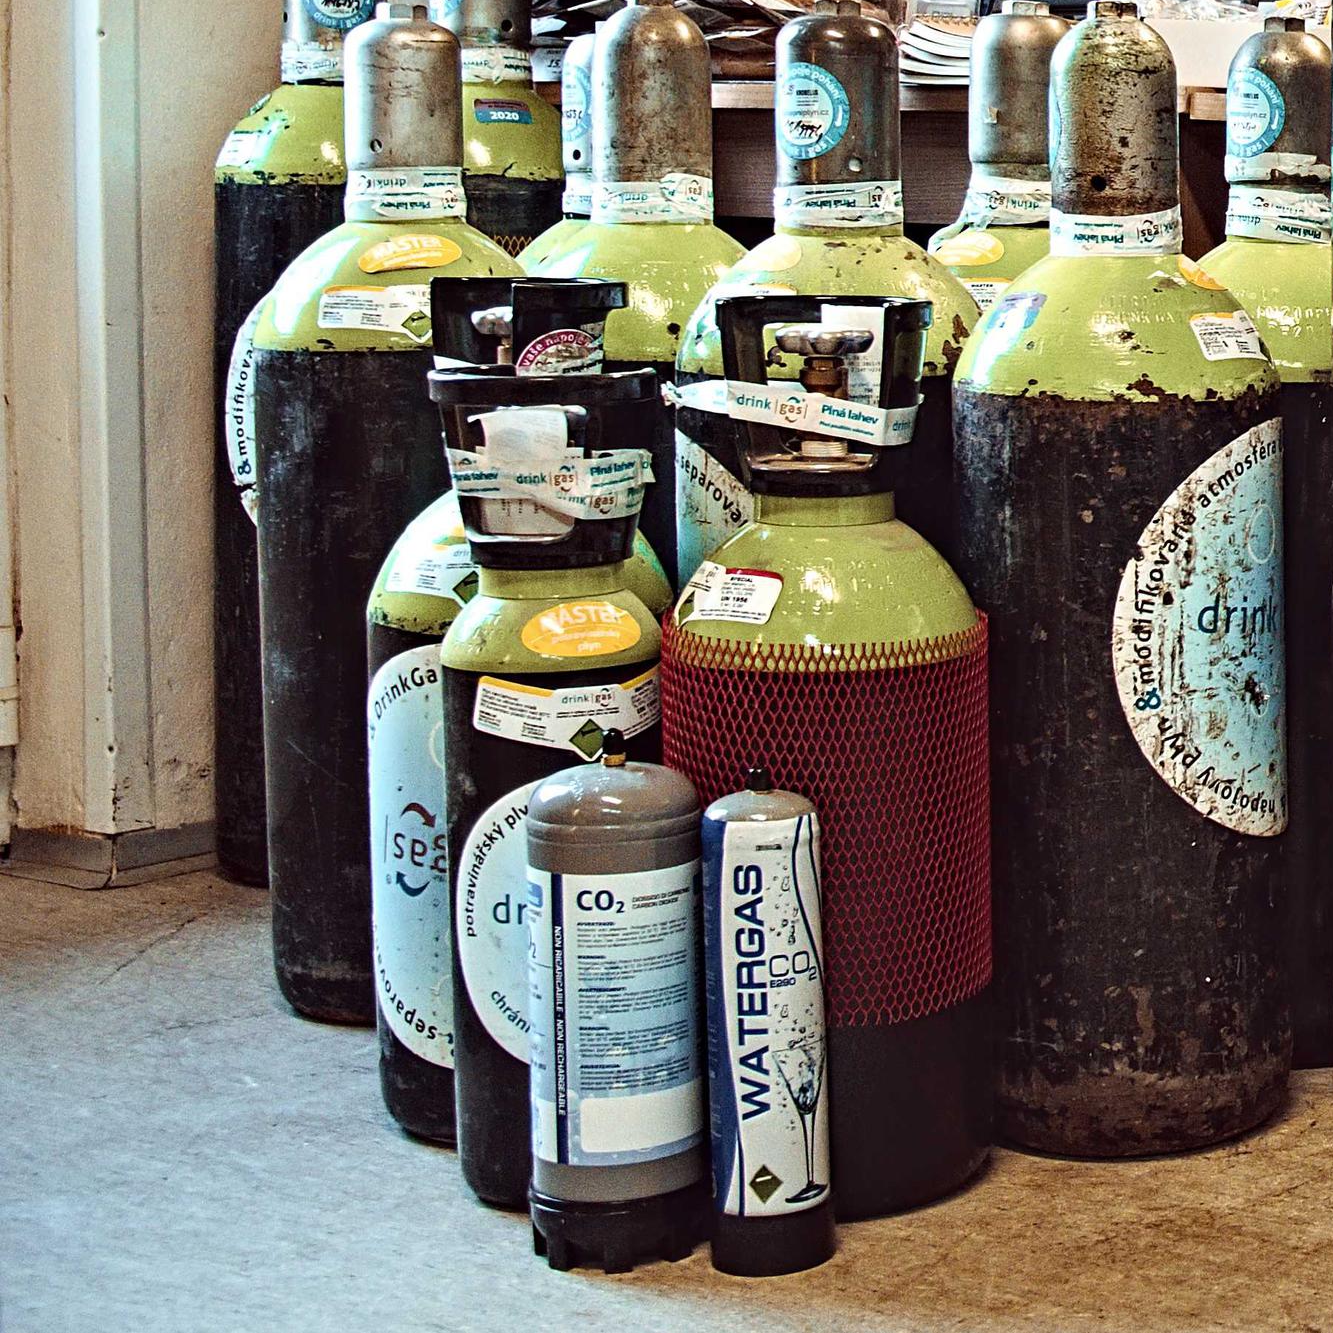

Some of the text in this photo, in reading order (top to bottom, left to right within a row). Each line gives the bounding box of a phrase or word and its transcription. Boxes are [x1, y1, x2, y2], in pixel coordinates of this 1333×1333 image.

[489, 110, 520, 121] 2020
[372, 232, 442, 262] MASTER
[521, 341, 545, 367] vaše
[735, 392, 772, 411] drink
[778, 399, 804, 417] gas
[820, 403, 848, 422] Plná
[849, 408, 880, 426] lahev
[237, 455, 253, 475] &
[515, 471, 546, 487] drink
[554, 472, 575, 488] gas
[589, 462, 610, 477] Plná
[612, 459, 636, 474] lahev
[1197, 594, 1278, 634] drink
[560, 691, 615, 706] drink gas
[465, 823, 505, 938] potravinářský
[731, 862, 773, 1121] WATERGAS
[769, 976, 797, 989] E290
[553, 925, 567, 1116] NON RICARICABILE NON RECHARGEABLE
